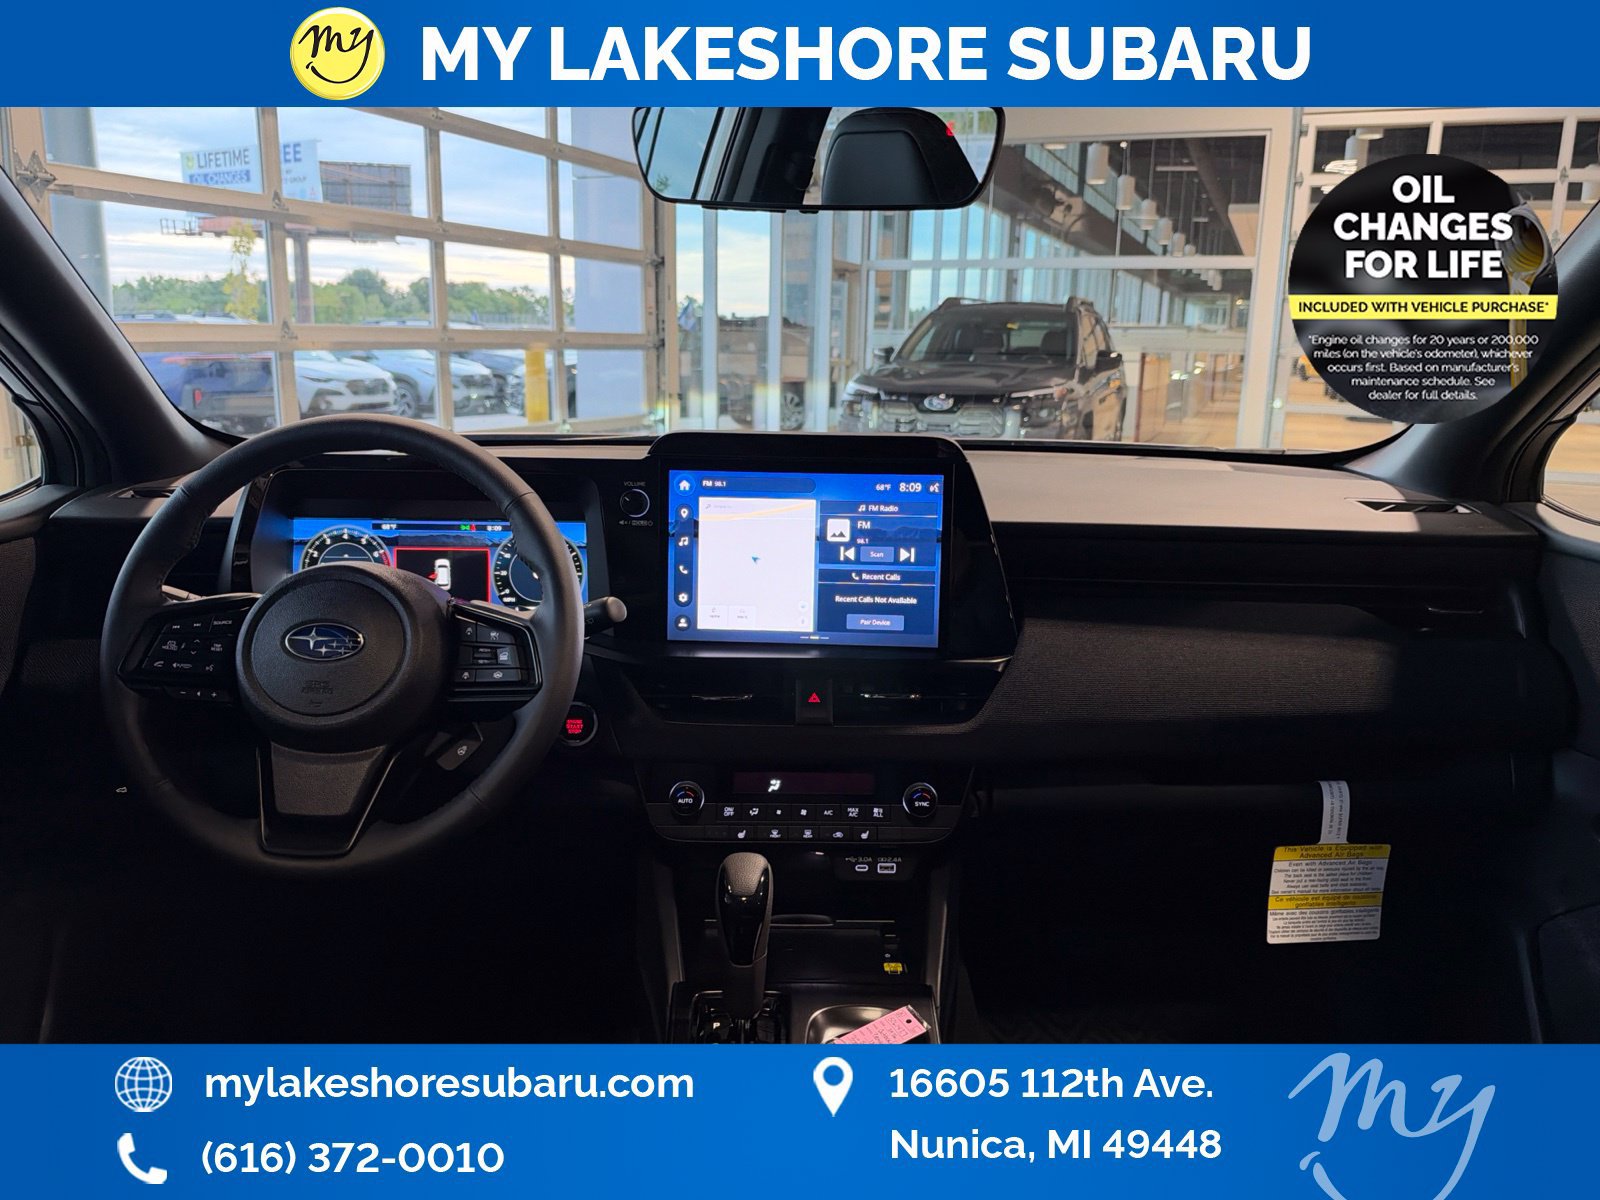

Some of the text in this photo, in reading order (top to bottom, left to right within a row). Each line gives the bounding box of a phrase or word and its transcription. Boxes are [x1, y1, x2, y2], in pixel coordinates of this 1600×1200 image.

[196, 148, 250, 169] LIFETIME
[283, 144, 302, 163] EE
[207, 170, 248, 184] CHANGES
[900, 482, 922, 492] 8:09
[858, 521, 870, 529] FM
